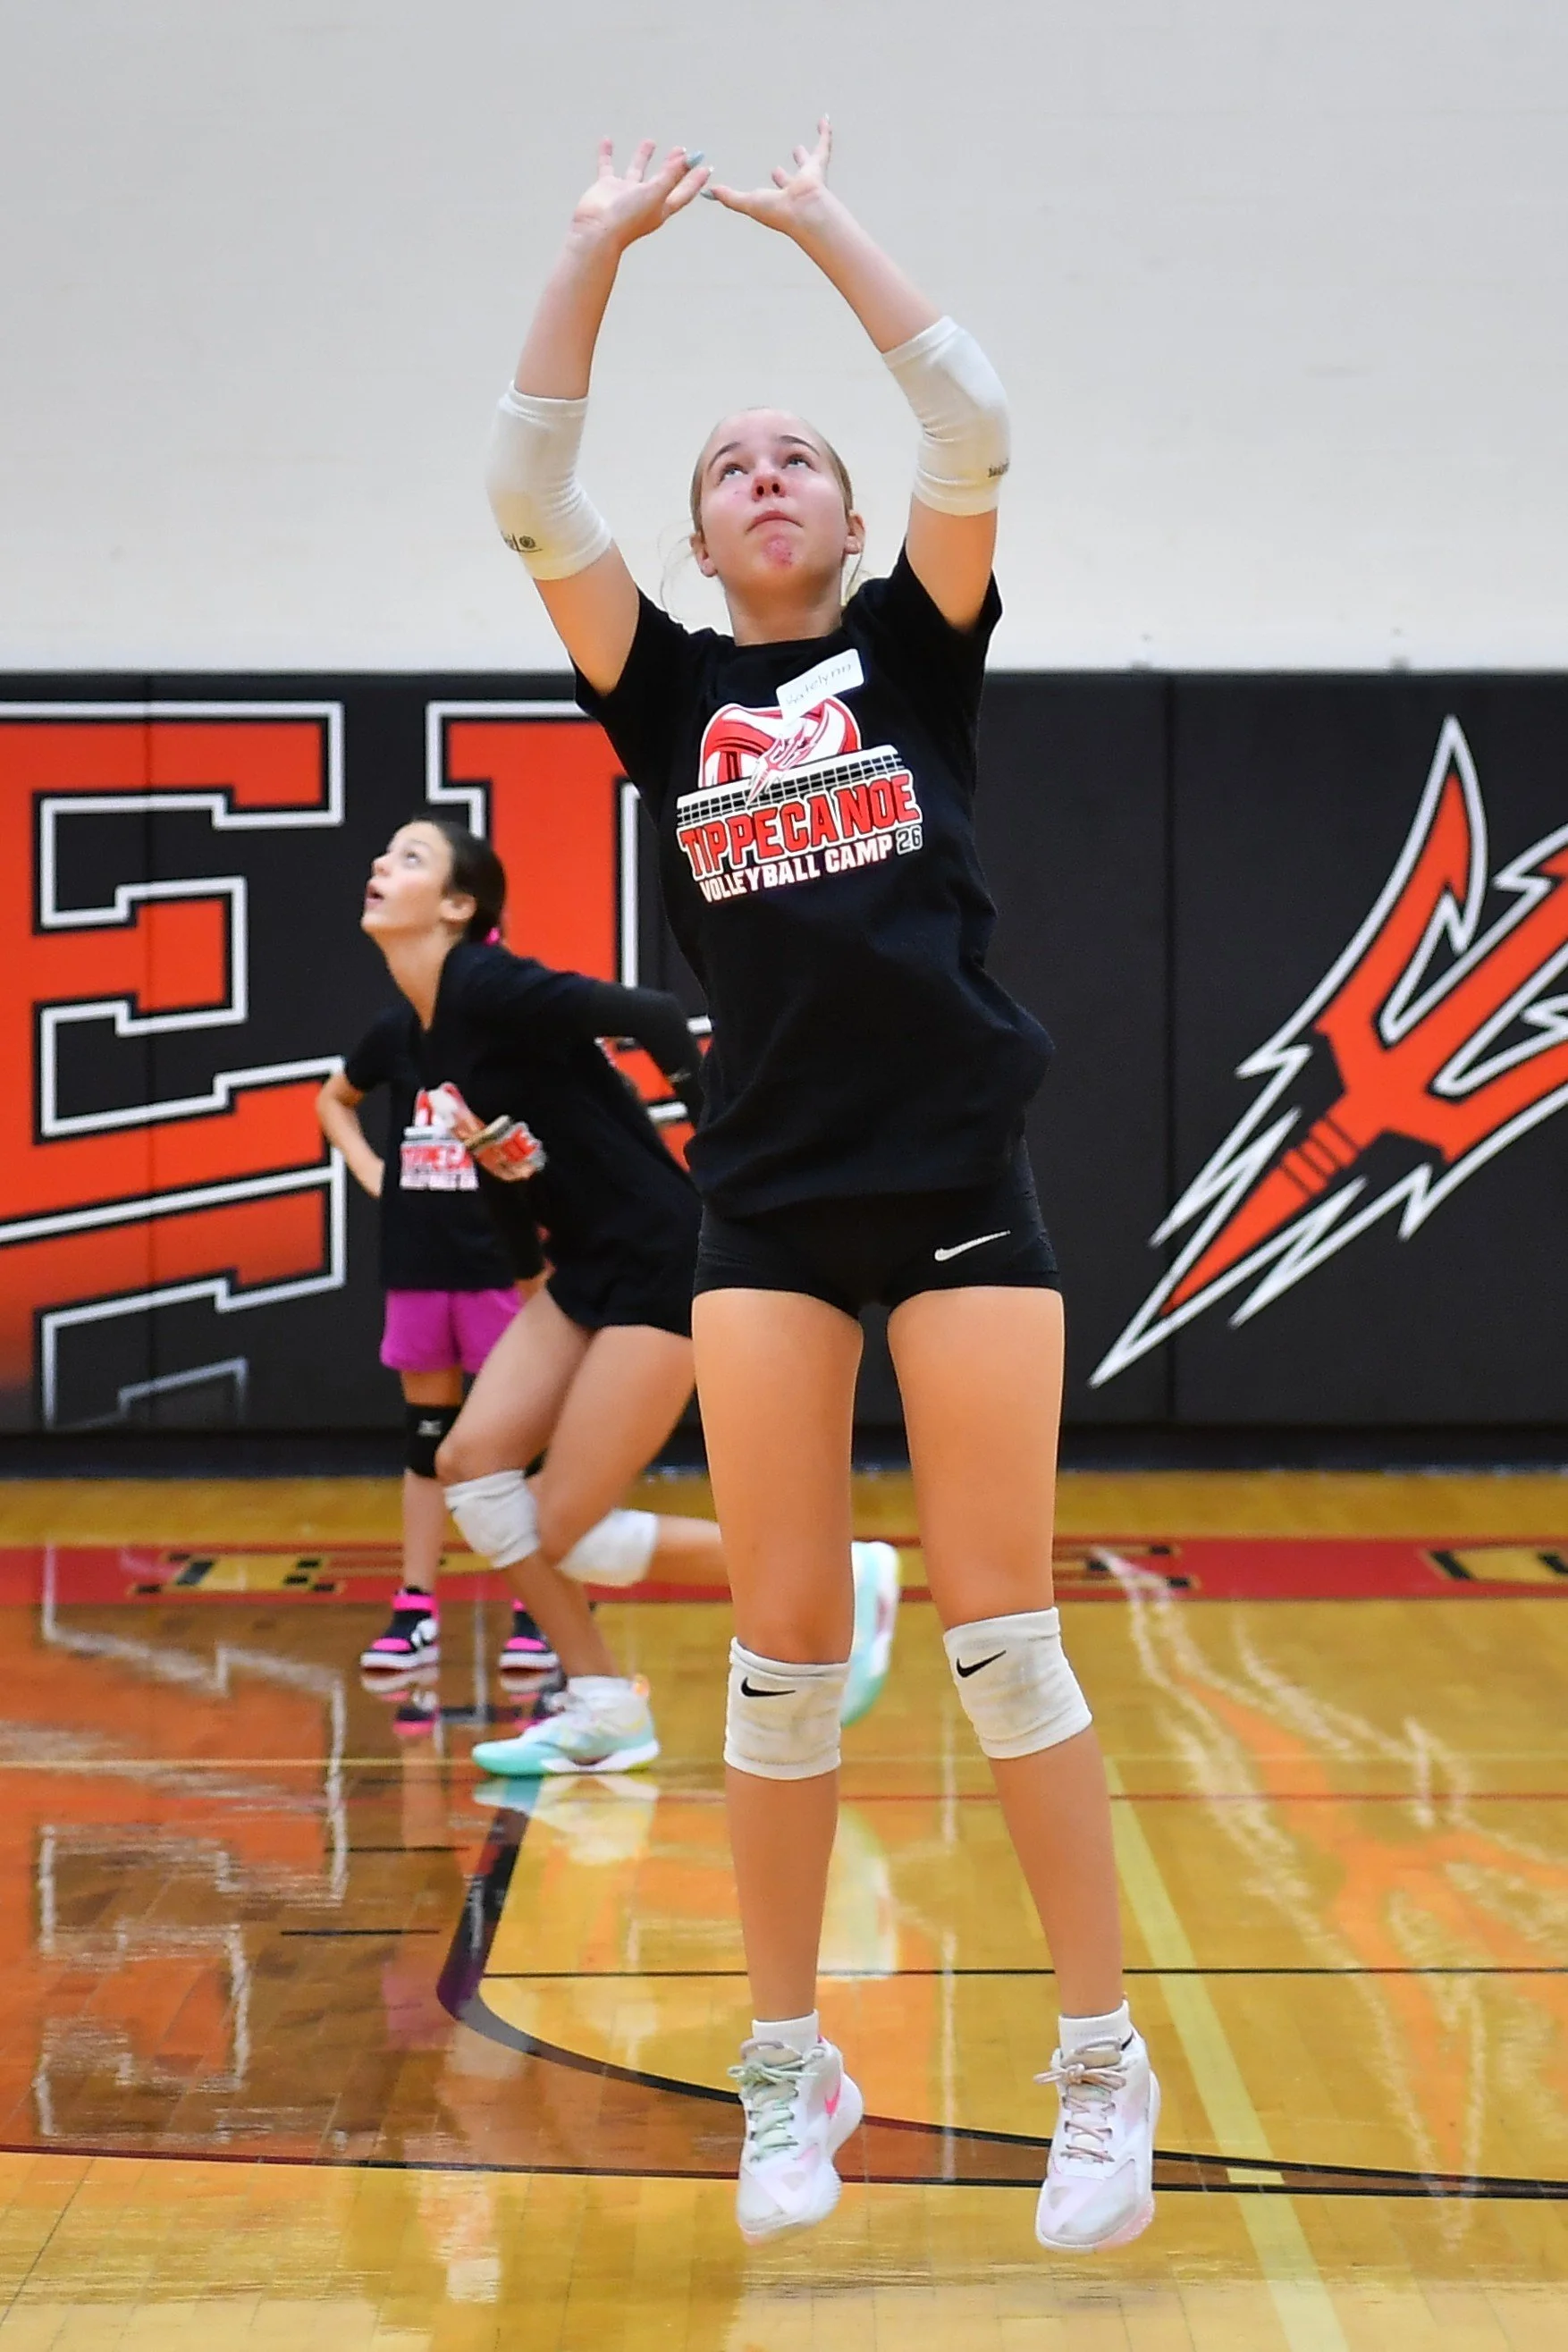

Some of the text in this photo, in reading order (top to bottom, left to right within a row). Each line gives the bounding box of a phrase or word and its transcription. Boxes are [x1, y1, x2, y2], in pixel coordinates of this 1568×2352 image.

[677, 771, 922, 880] TIPPECANOE
[699, 825, 923, 903] VOLLEYBALL CAMP 26
